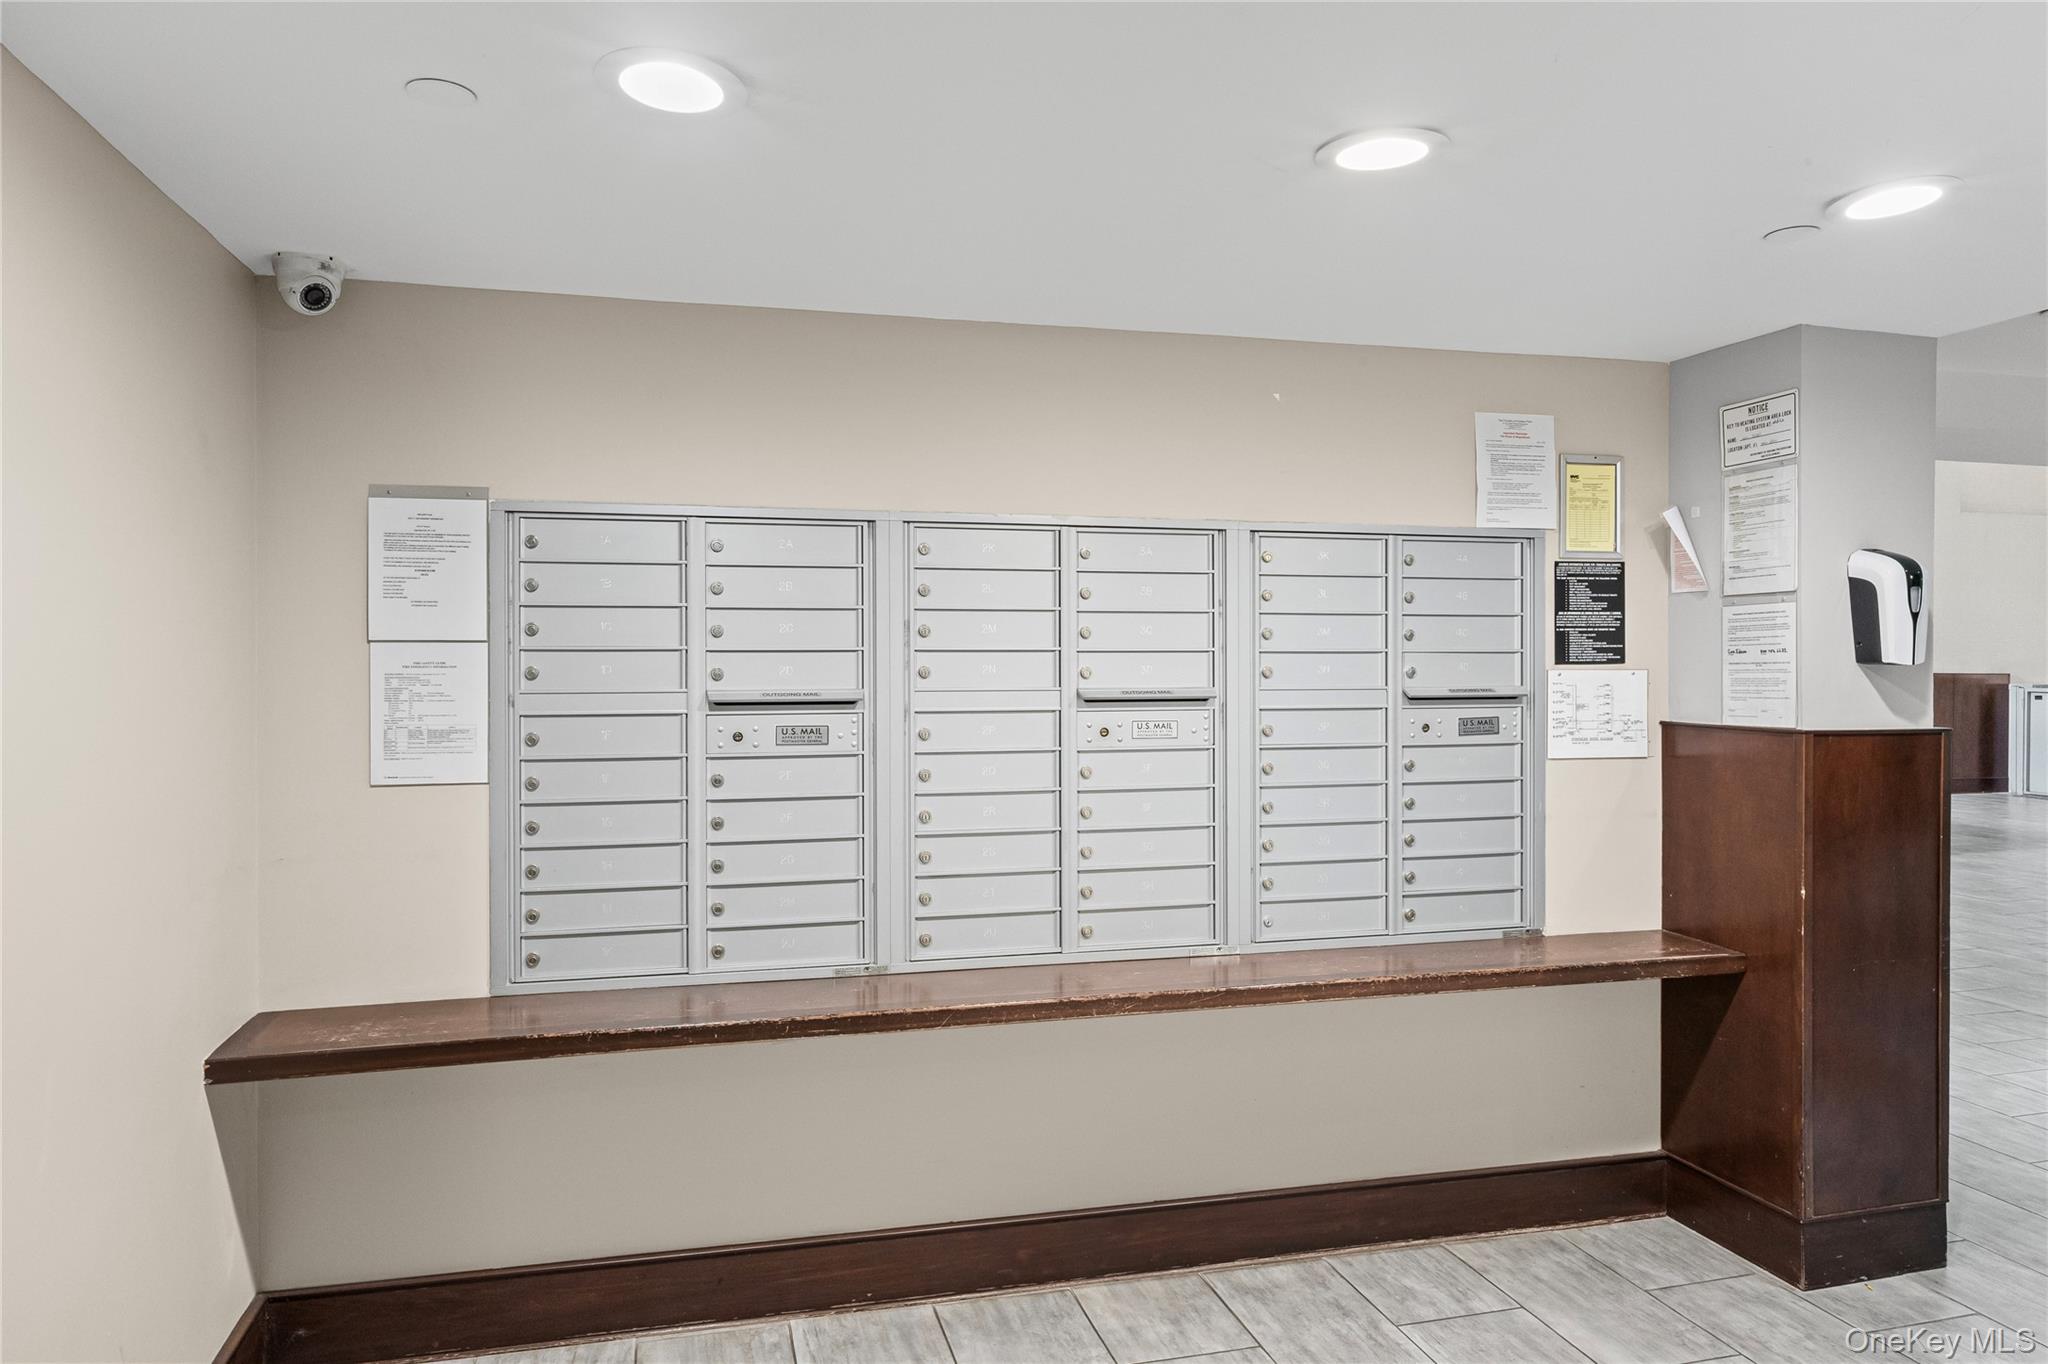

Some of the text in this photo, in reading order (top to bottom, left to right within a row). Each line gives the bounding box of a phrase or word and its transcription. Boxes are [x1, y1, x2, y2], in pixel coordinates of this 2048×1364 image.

[1748, 403, 1769, 414] NOTICE
[1756, 415, 1771, 423] SYSTEM
[800, 727, 822, 735] MAIL
